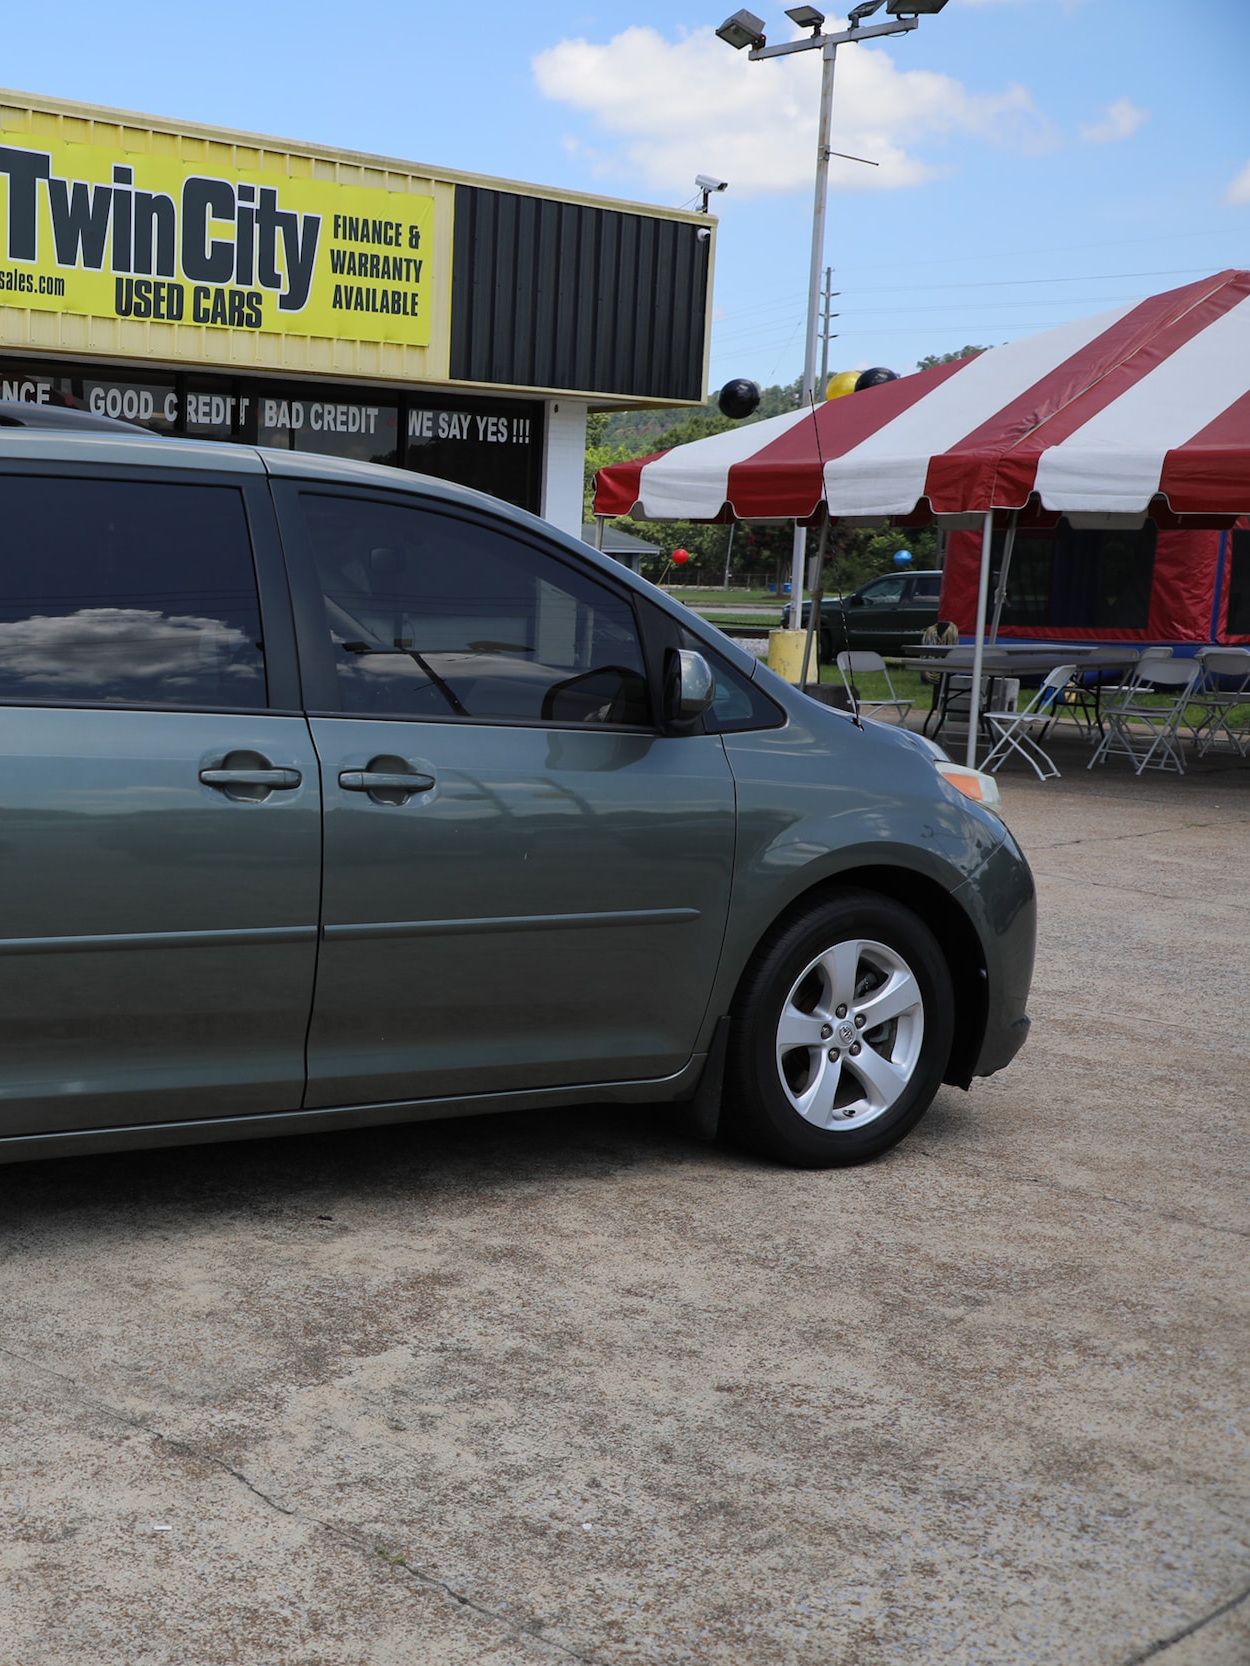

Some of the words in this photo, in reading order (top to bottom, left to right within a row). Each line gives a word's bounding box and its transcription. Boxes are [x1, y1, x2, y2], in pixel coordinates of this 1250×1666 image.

[333, 214, 402, 247] FINANCE
[408, 224, 421, 250] &
[330, 248, 423, 284] WARRANTY
[115, 277, 184, 321] USED
[192, 285, 262, 329] CARS
[332, 284, 419, 317] AVAILABLE
[89, 387, 154, 420] GOOD
[264, 400, 304, 430] BAD
[309, 403, 379, 434] CREDIT
[408, 409, 433, 438] WE
[438, 410, 472, 440] SAY
[476, 415, 508, 443] YES
